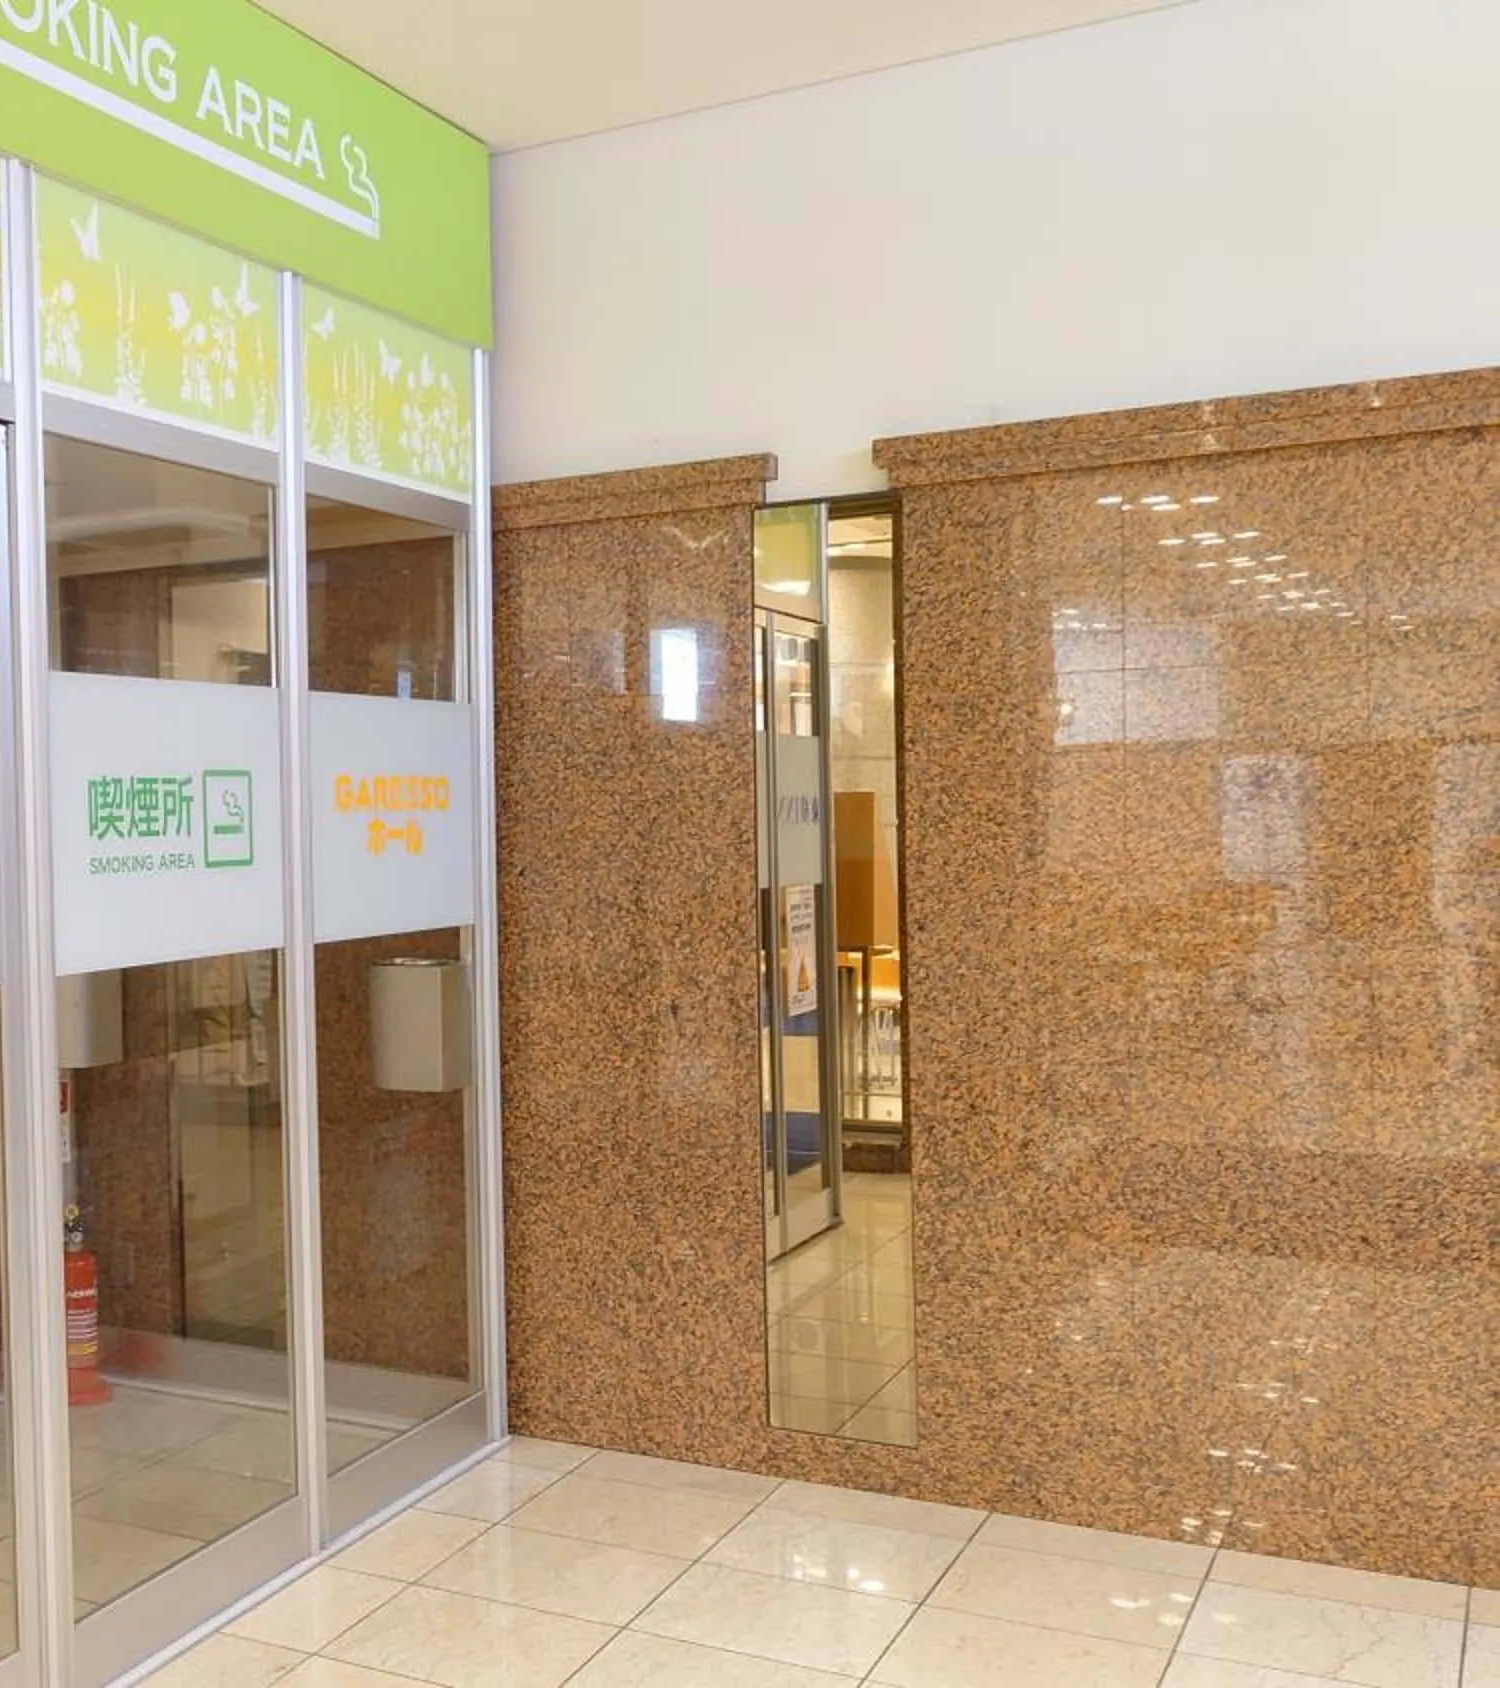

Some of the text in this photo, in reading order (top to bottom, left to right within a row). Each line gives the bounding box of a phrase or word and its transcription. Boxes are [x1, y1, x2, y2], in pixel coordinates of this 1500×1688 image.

[196, 66, 326, 180] AREA
[87, 776, 195, 841] 喫煙所
[366, 818, 423, 856] ホール
[88, 853, 196, 875] SMOKING AREA
